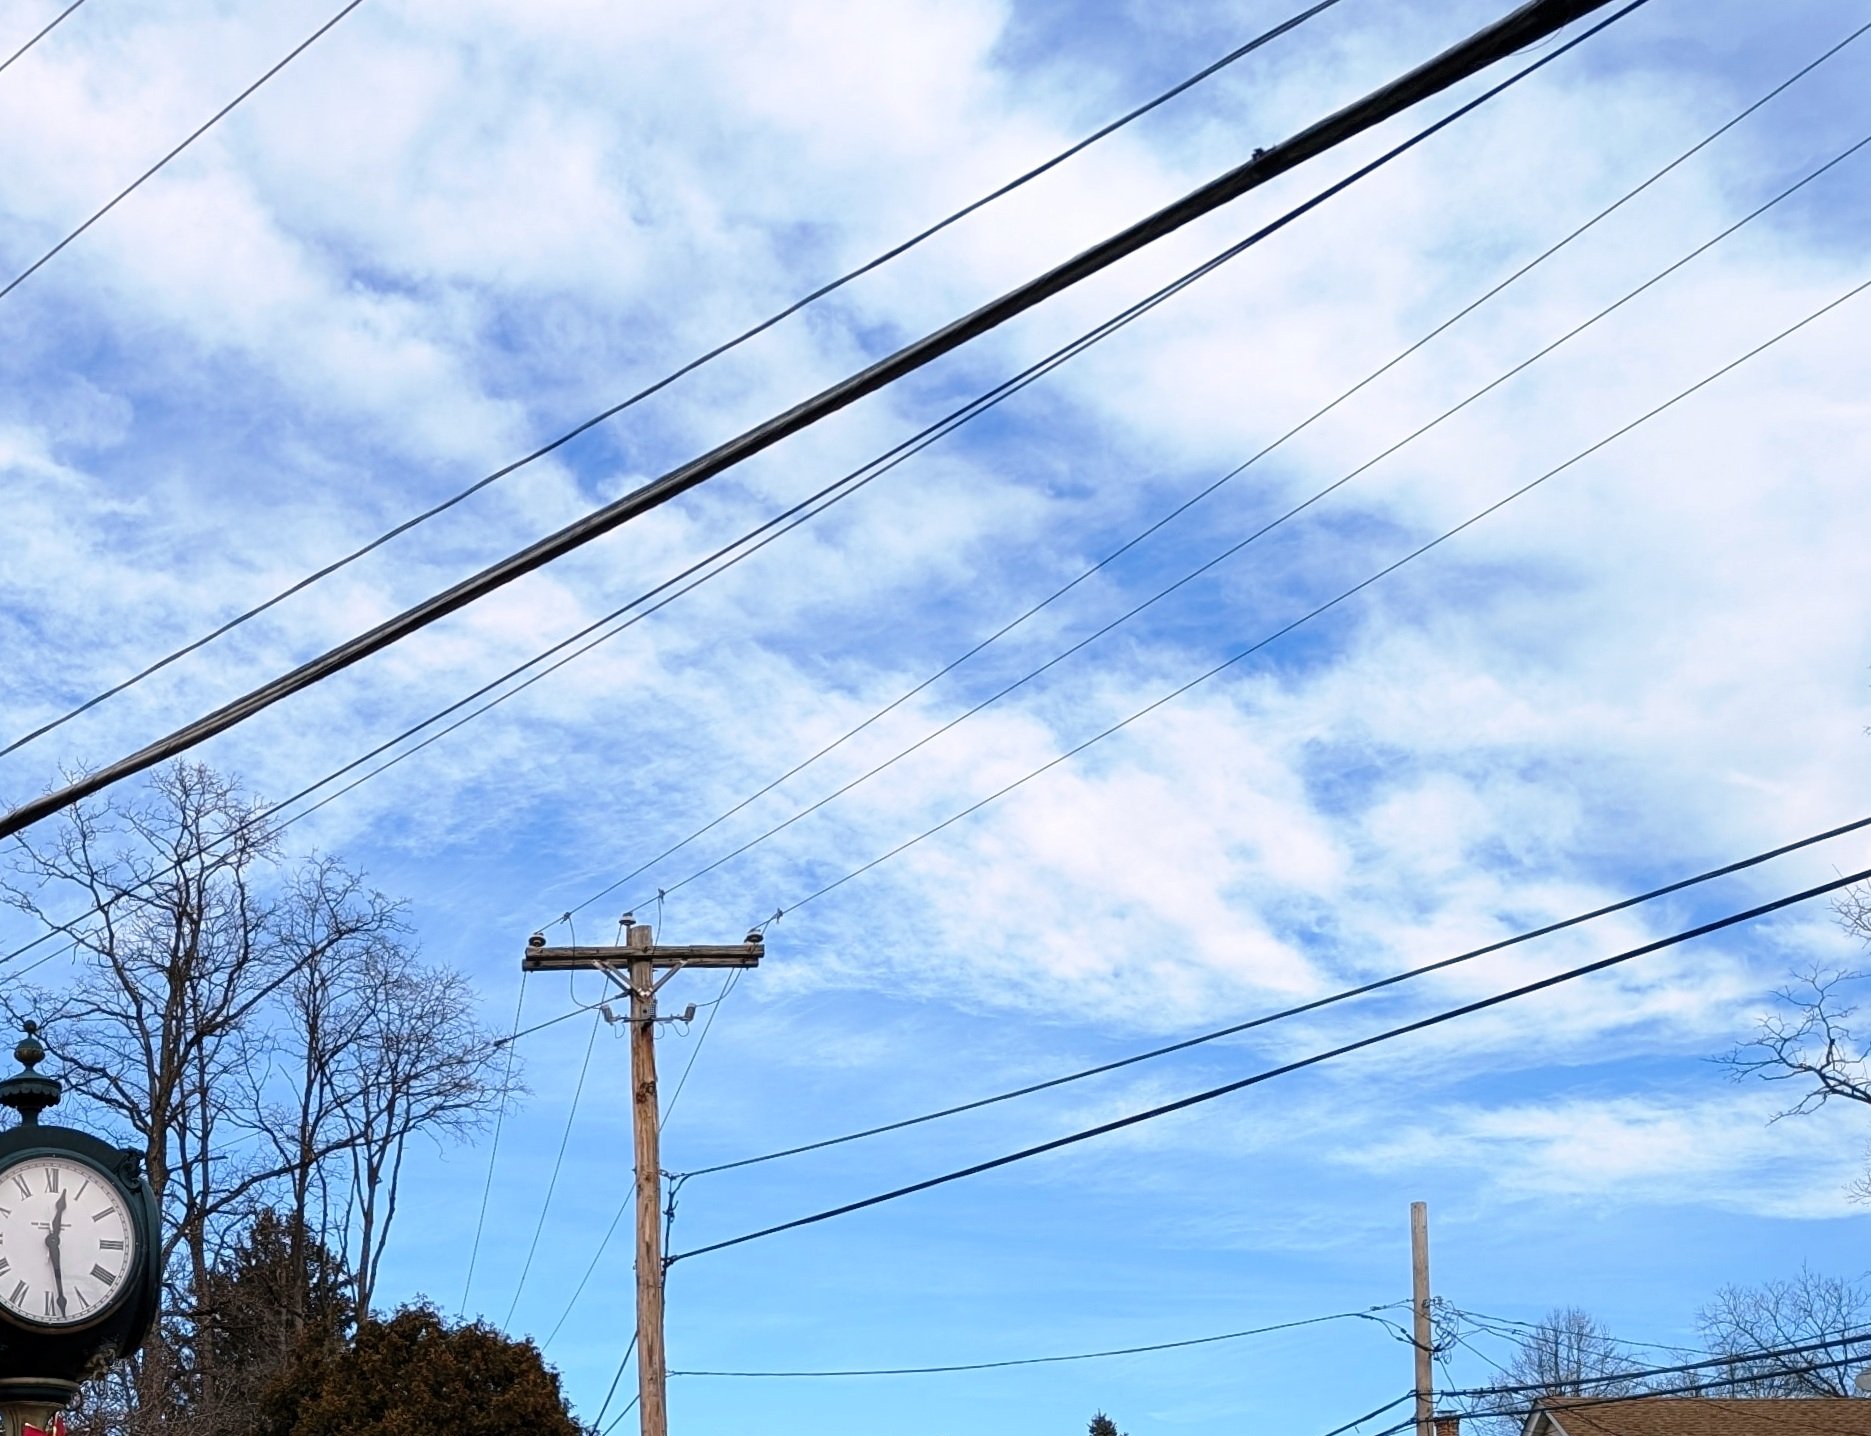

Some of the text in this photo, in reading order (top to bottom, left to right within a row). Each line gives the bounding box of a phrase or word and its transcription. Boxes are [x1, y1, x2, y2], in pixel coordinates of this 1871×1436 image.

[13, 1173, 33, 1202] XI
[44, 1167, 60, 1194] XII
[91, 1206, 116, 1223] II
[99, 1239, 125, 1251] III
